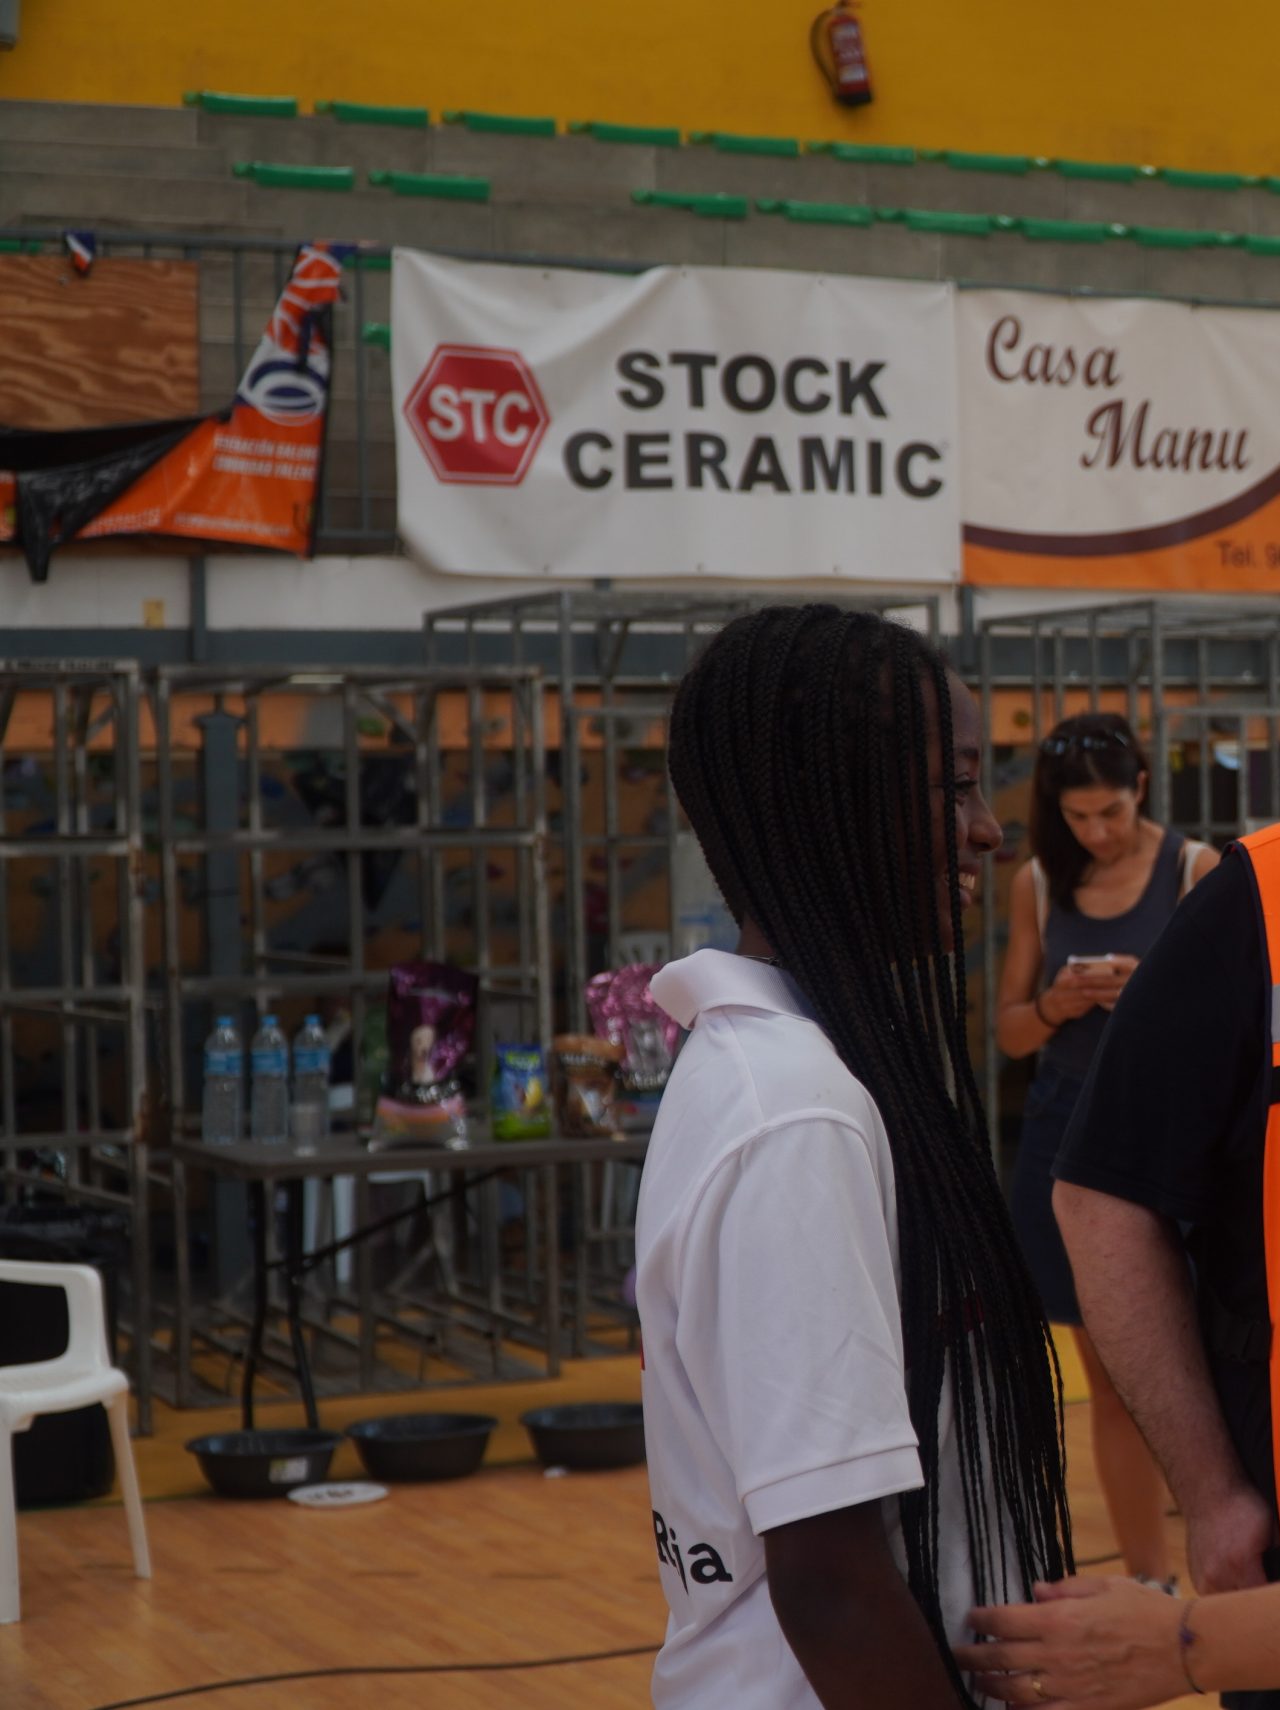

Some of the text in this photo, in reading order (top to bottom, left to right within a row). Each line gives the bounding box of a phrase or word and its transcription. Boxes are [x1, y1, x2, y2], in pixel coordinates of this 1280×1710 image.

[616, 351, 888, 418] STOCK
[985, 315, 1121, 387] Casa
[427, 383, 530, 446] STC
[1079, 399, 1251, 472] Manu
[563, 430, 944, 499] CERAMIC
[1216, 540, 1256, 567] Tel.
